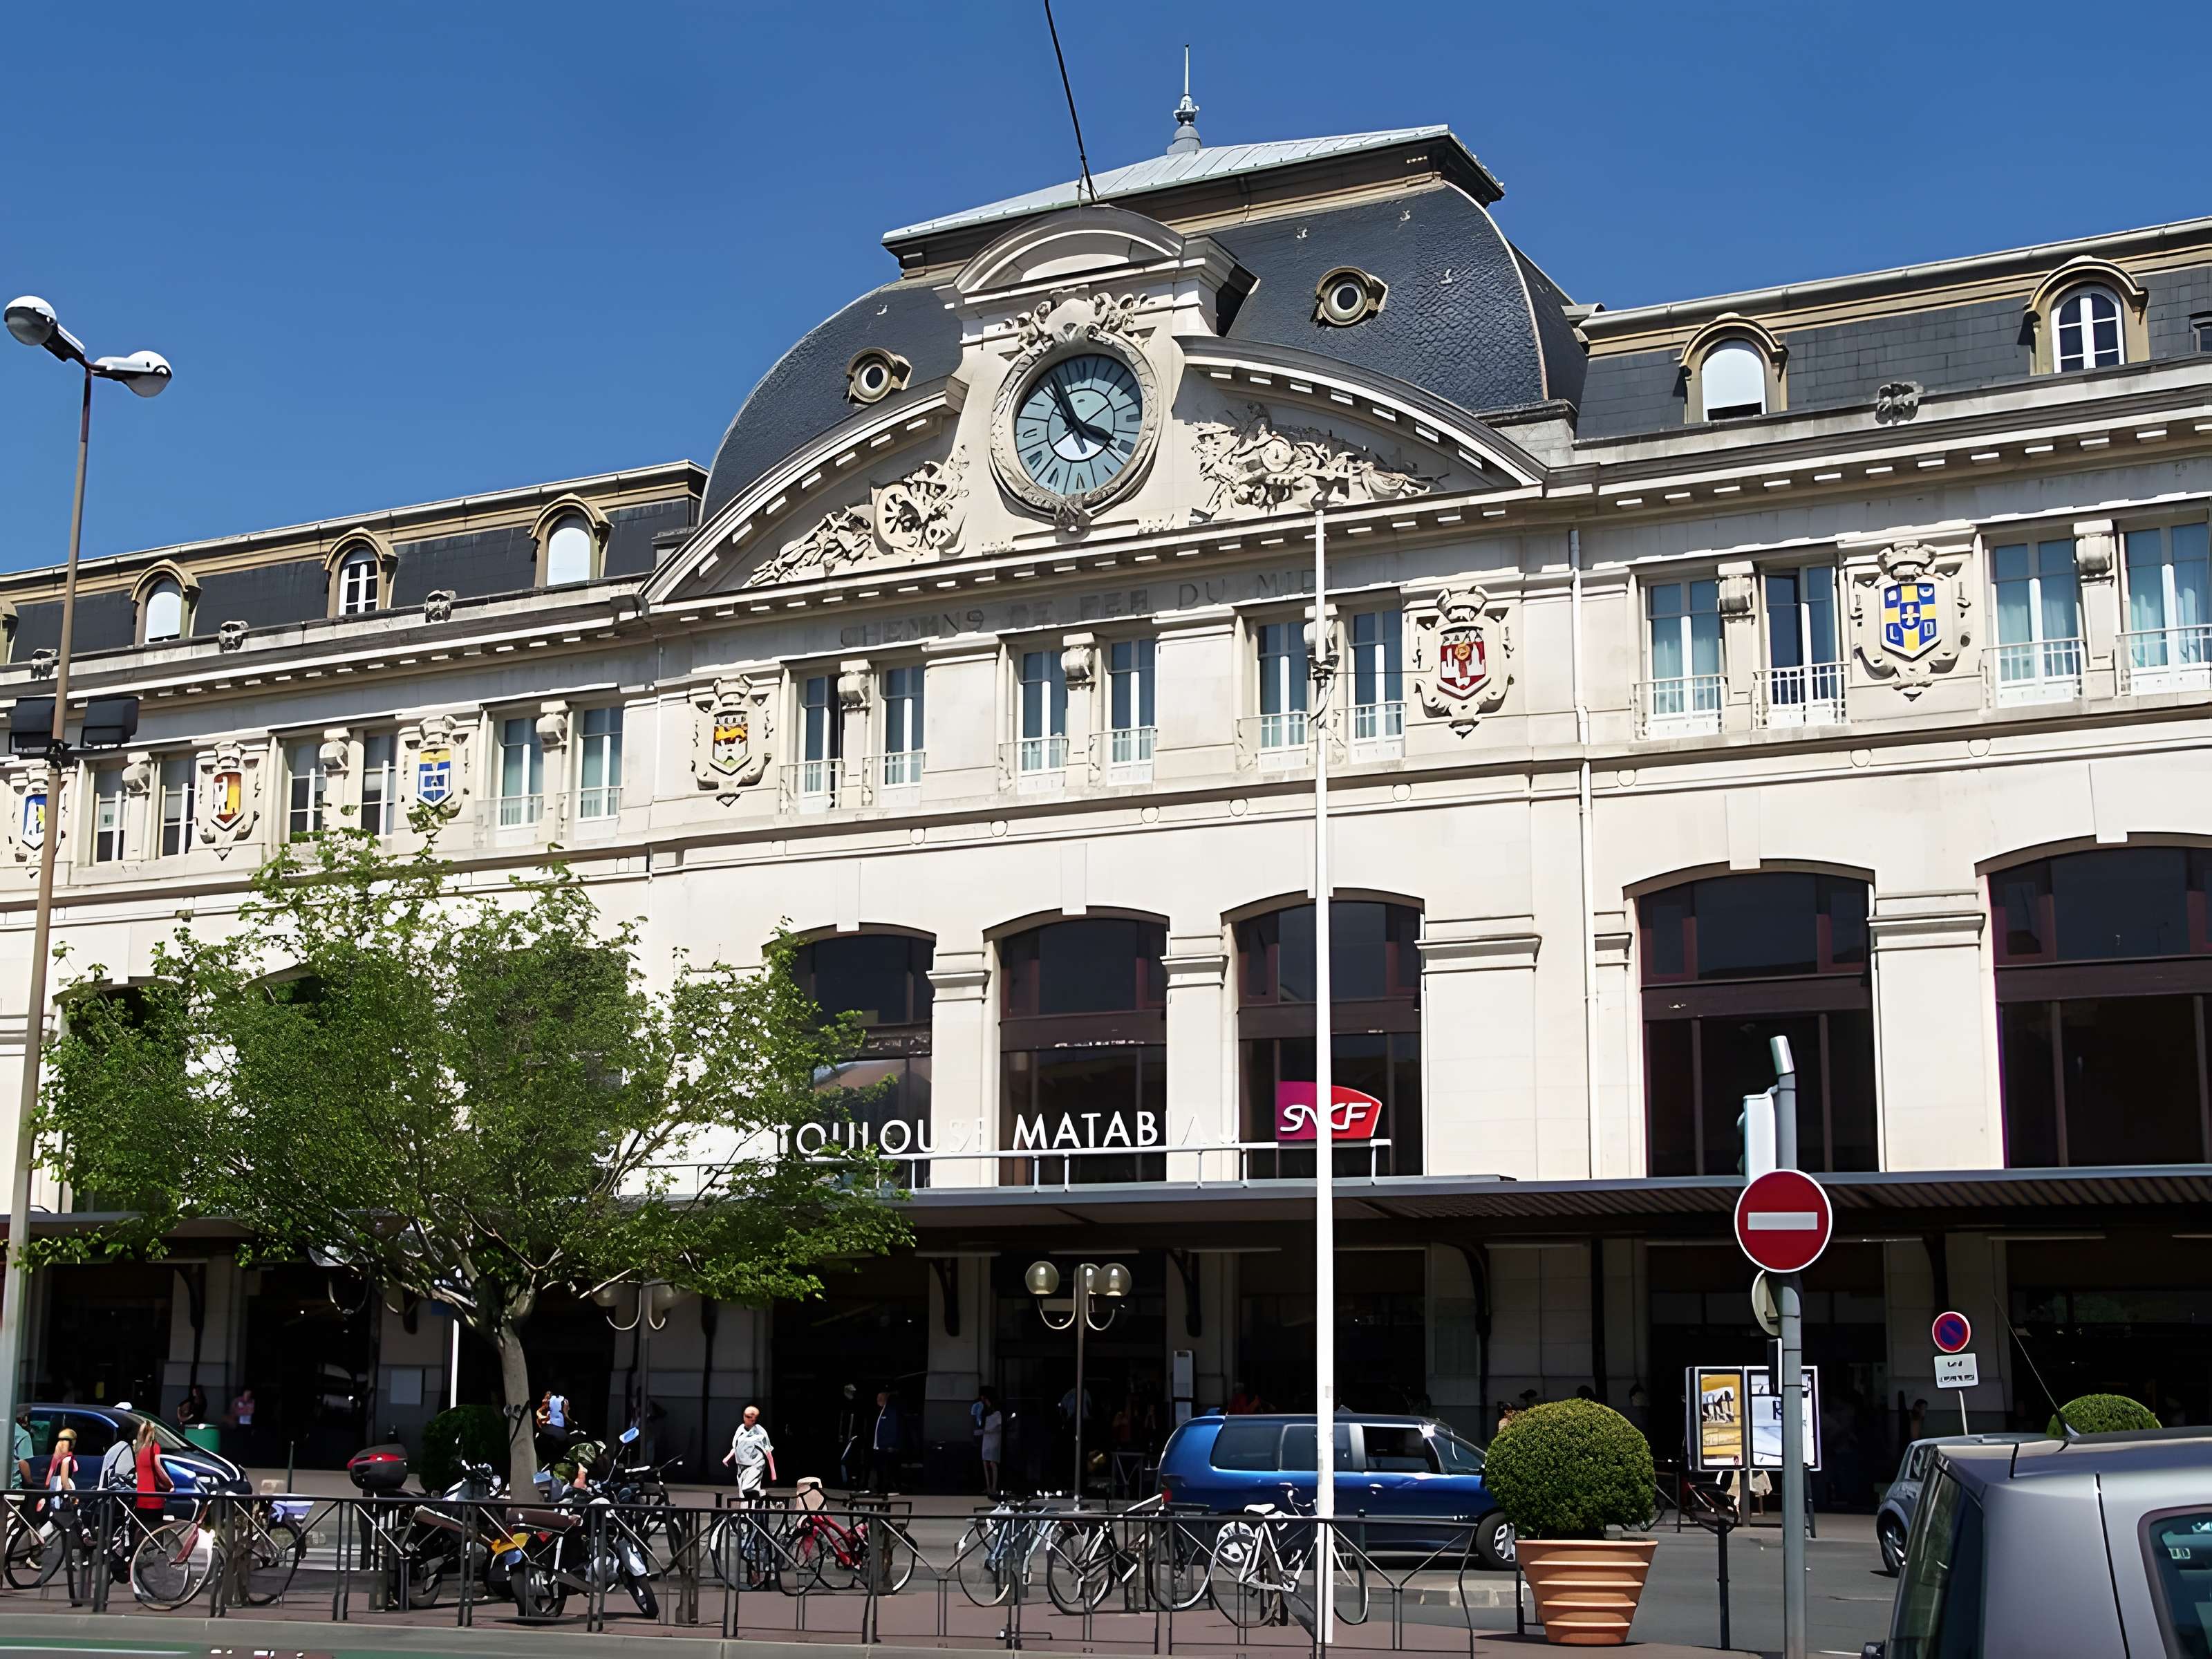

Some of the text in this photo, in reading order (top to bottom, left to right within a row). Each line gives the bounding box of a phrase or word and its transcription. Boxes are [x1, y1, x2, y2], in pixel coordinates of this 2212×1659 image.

[1178, 578, 1225, 610] DU
[1013, 1110, 1239, 1150] MATABAU
[1280, 1102, 1372, 1132] SNCF
